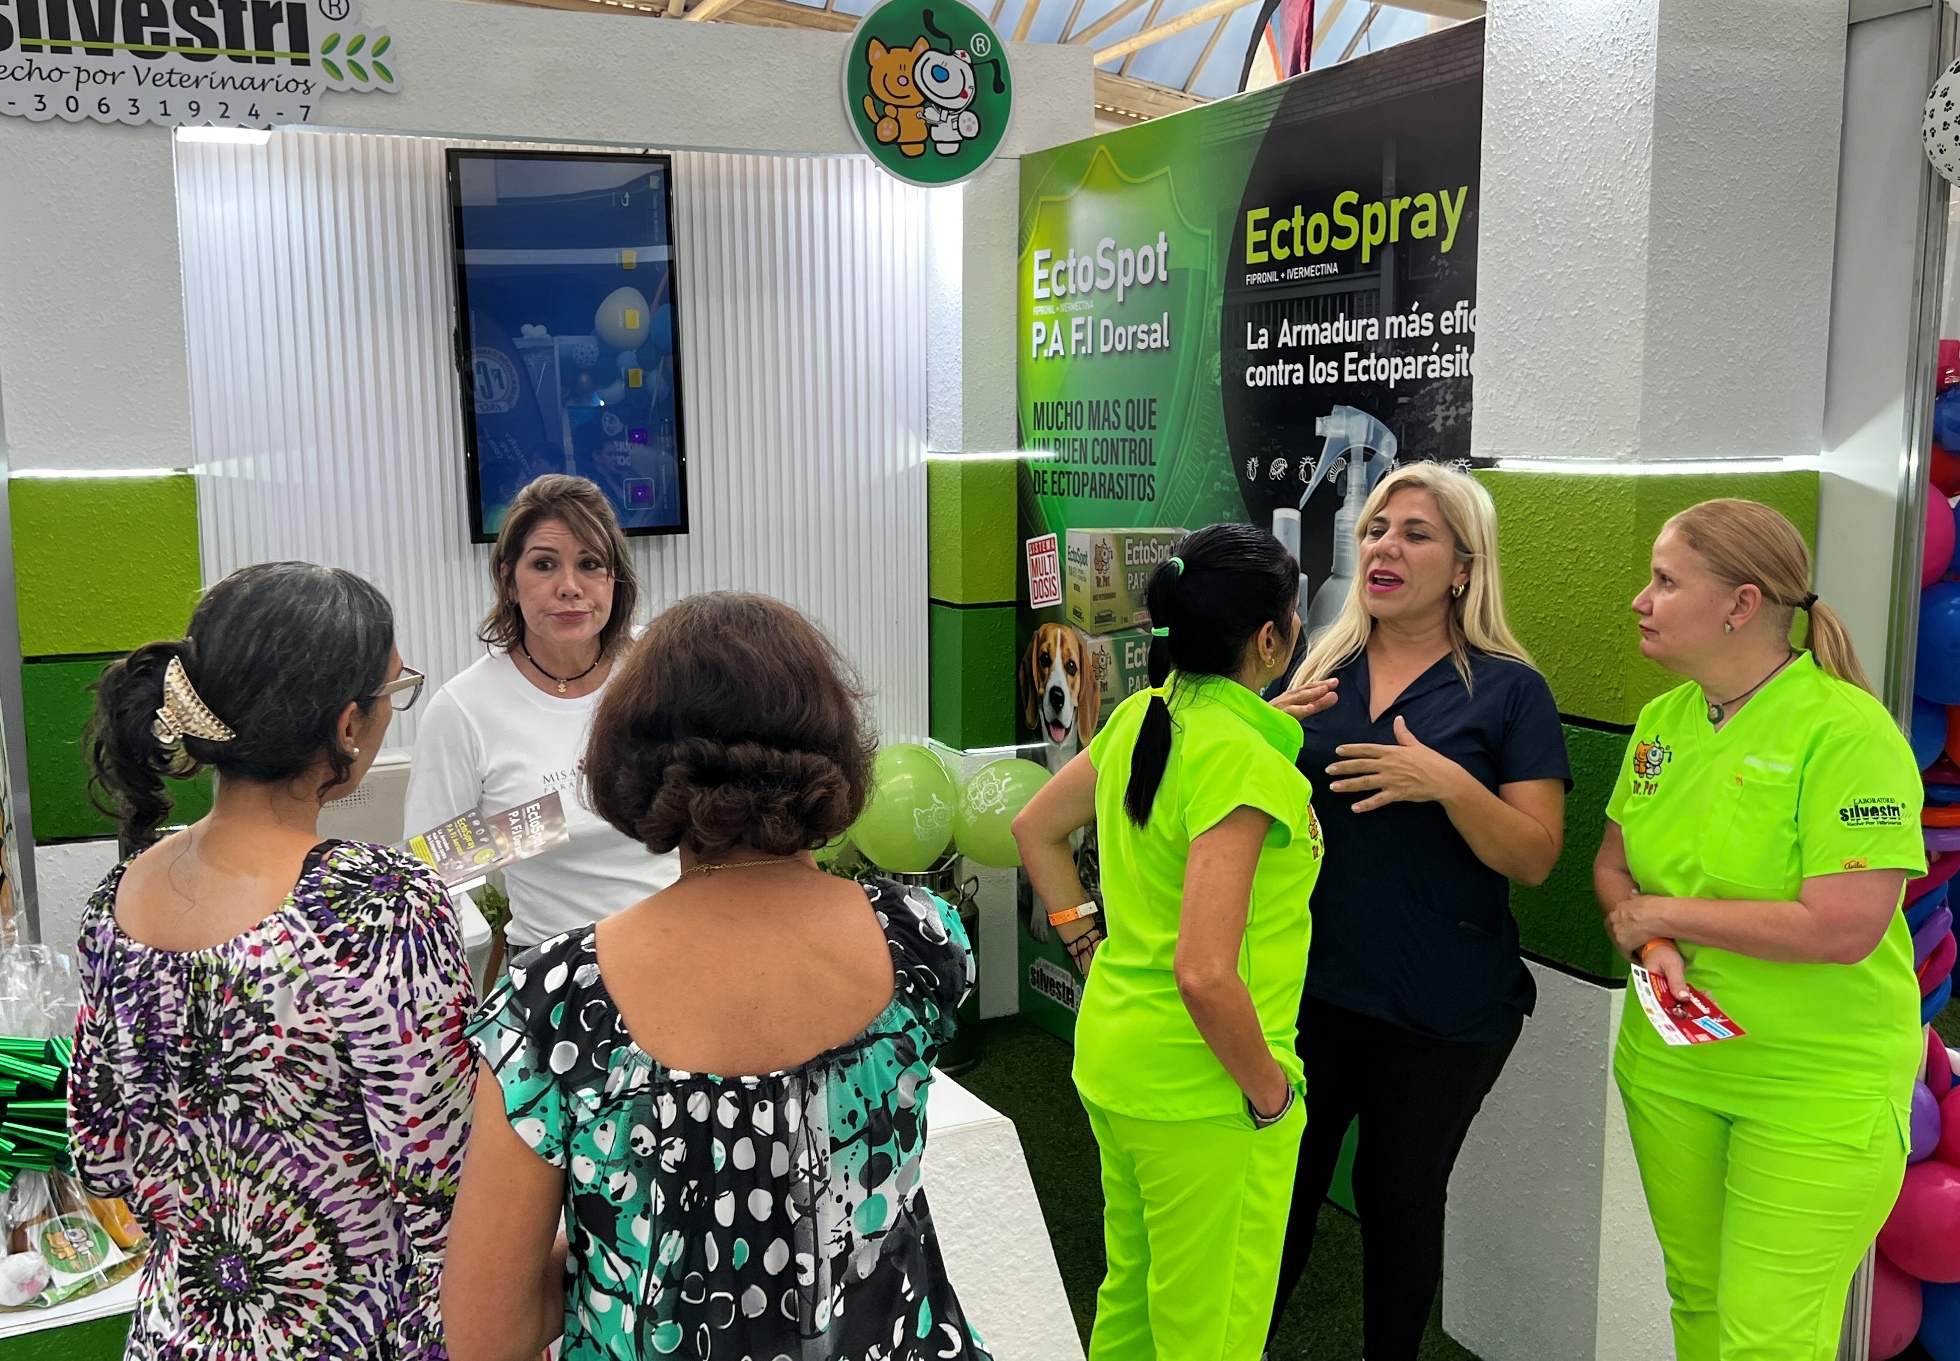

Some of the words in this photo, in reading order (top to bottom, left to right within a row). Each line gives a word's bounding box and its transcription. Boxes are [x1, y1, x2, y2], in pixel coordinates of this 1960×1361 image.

[74, 65, 126, 92] por
[133, 65, 316, 95] Veterinarios
[1246, 185, 1468, 265] EctoSpray
[1033, 231, 1168, 302] EctoSpot
[1246, 272, 1279, 285] FIPRONIL
[1287, 262, 1339, 280] IVERMECTINA
[1100, 312, 1169, 353] Dorsal
[1246, 322, 1269, 351] La
[1277, 312, 1378, 348] Armadura
[1385, 301, 1434, 340] más
[1245, 359, 1304, 387] contra
[1309, 354, 1339, 384] los
[1033, 400, 1084, 431] MUCHO
[1088, 399, 1121, 431] MAS
[1125, 398, 1157, 433] QUE
[1033, 437, 1050, 464] UN
[1053, 437, 1088, 465] BUEN
[1092, 437, 1157, 467] CONTROL
[1033, 469, 1048, 496] DE
[1051, 470, 1156, 502] ECTOPARASITOS
[1029, 538, 1055, 556] SISTEMA
[1031, 554, 1056, 578] MULTI
[1033, 576, 1058, 600] DOSIS
[543, 771, 567, 784] MIS
[1643, 781, 1658, 795] Pet
[456, 817, 476, 850] EctoSpray
[526, 802, 547, 849] EctoSpot
